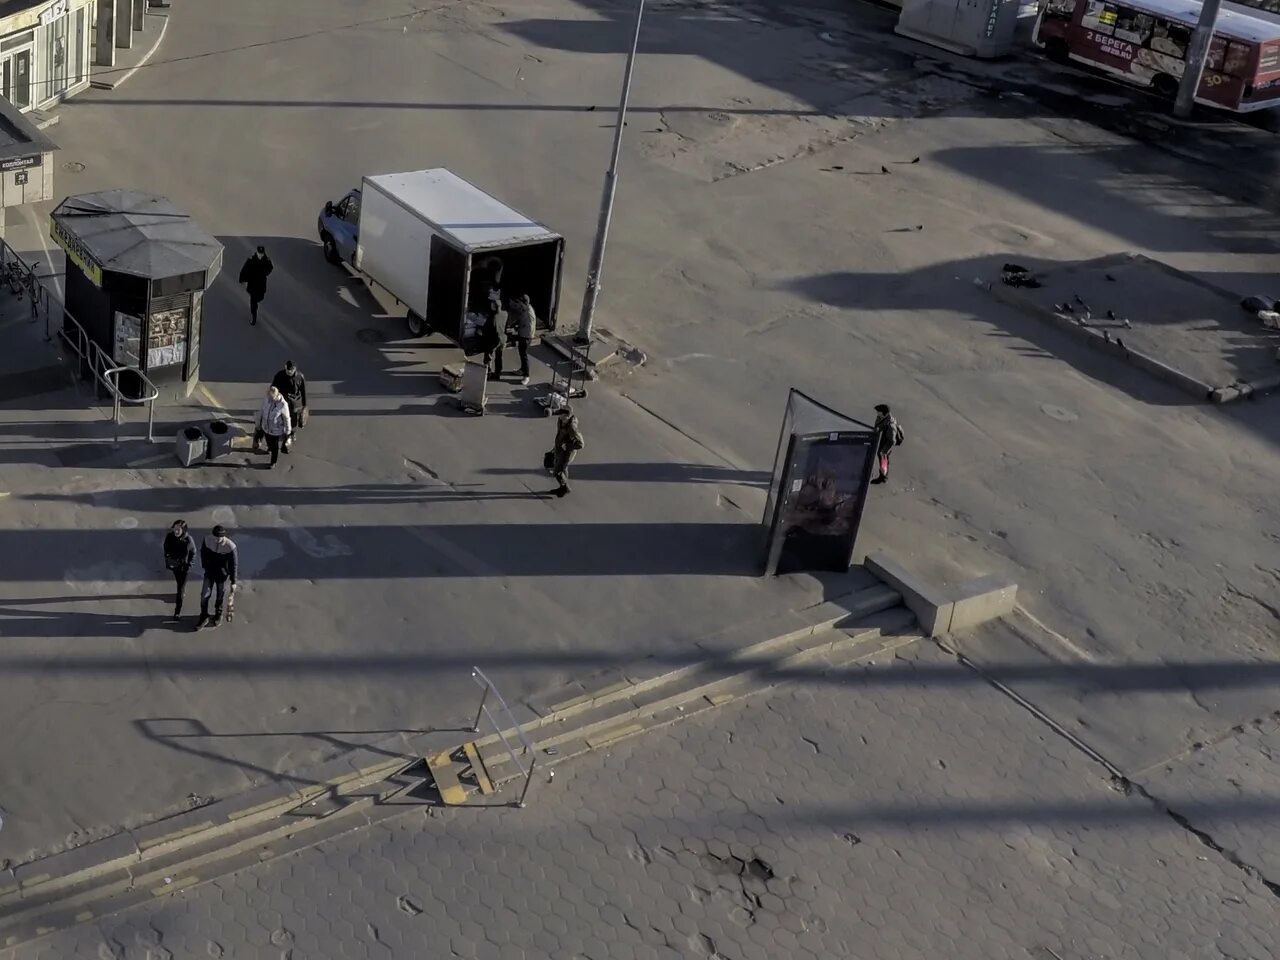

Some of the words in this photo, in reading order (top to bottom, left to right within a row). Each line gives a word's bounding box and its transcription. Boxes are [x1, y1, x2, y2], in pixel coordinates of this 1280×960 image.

[986, 0, 998, 37] ТУАЛЕТ
[1086, 31, 1093, 40] 2
[1095, 34, 1133, 53] БЕРЕГА
